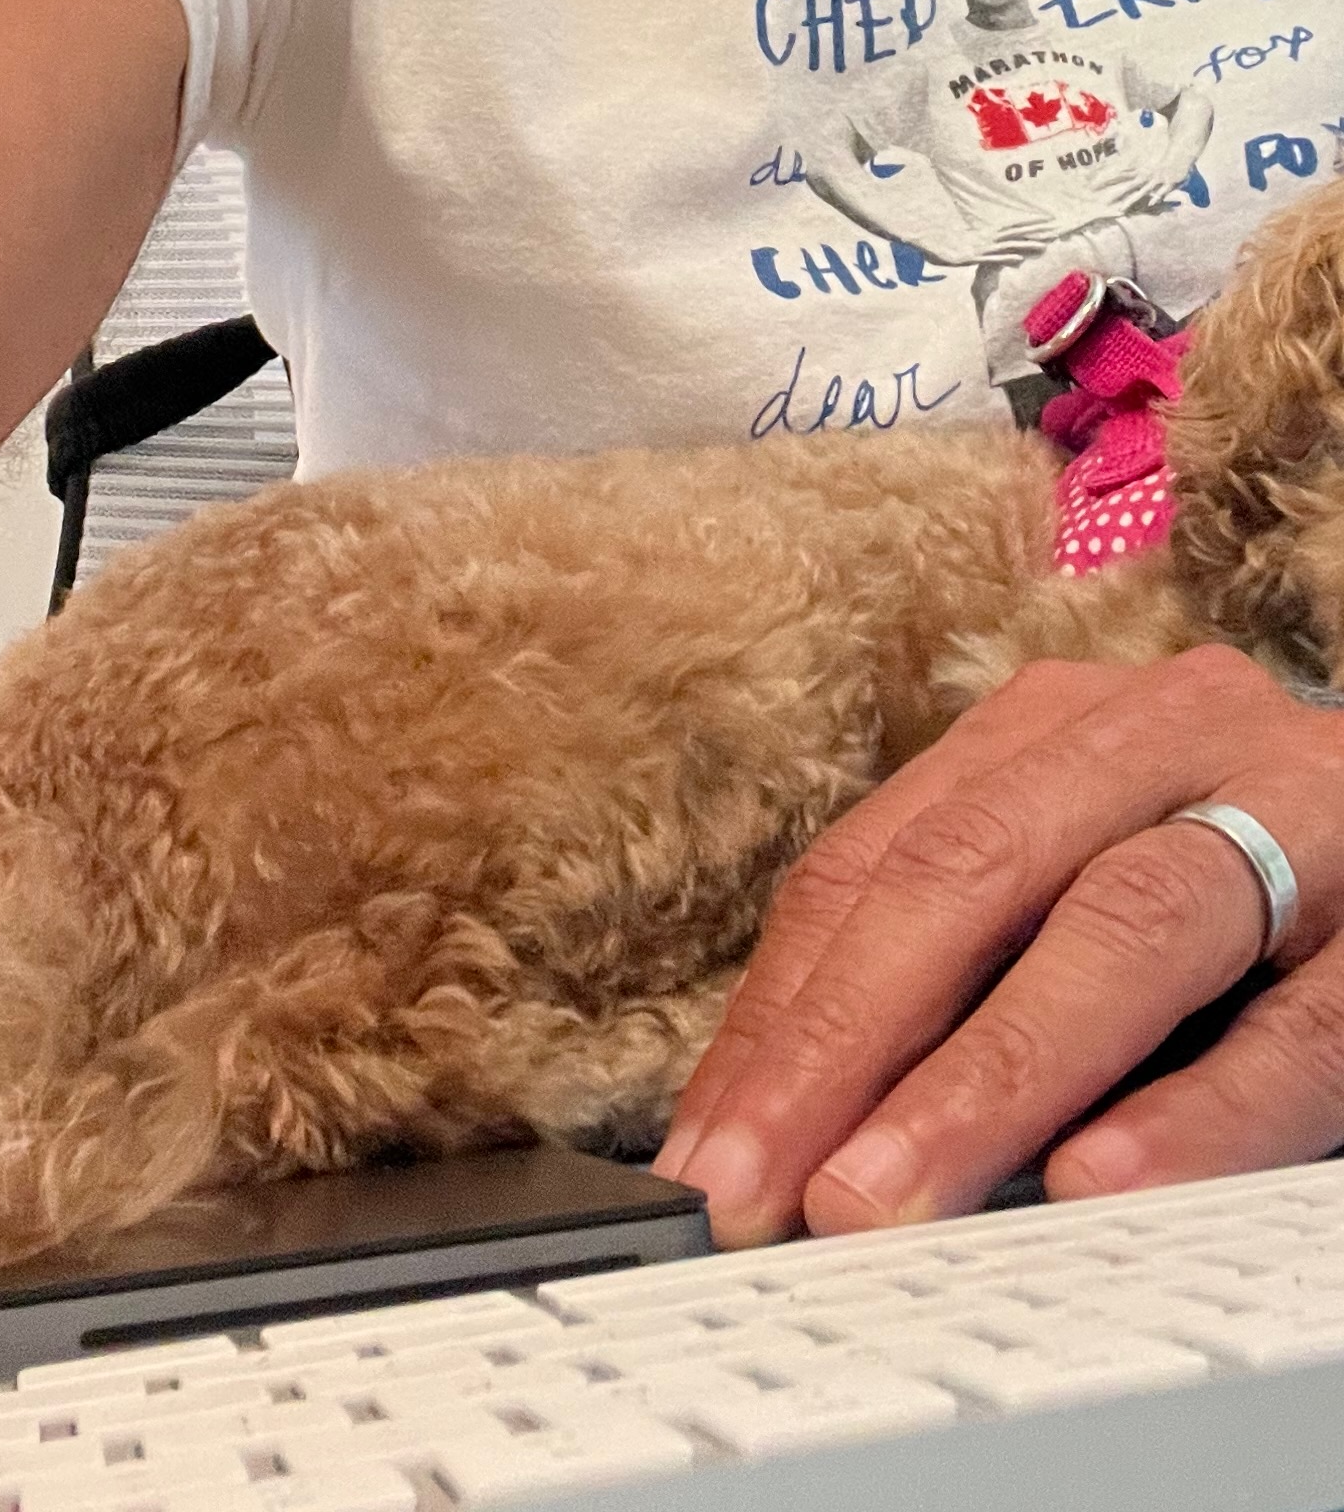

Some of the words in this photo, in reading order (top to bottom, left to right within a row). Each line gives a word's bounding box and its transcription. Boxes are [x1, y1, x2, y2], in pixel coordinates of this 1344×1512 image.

[948, 50, 1104, 100] MARATHON
[1004, 158, 1045, 183] OF
[1056, 137, 1119, 171] HOPE
[750, 345, 962, 440] dear
